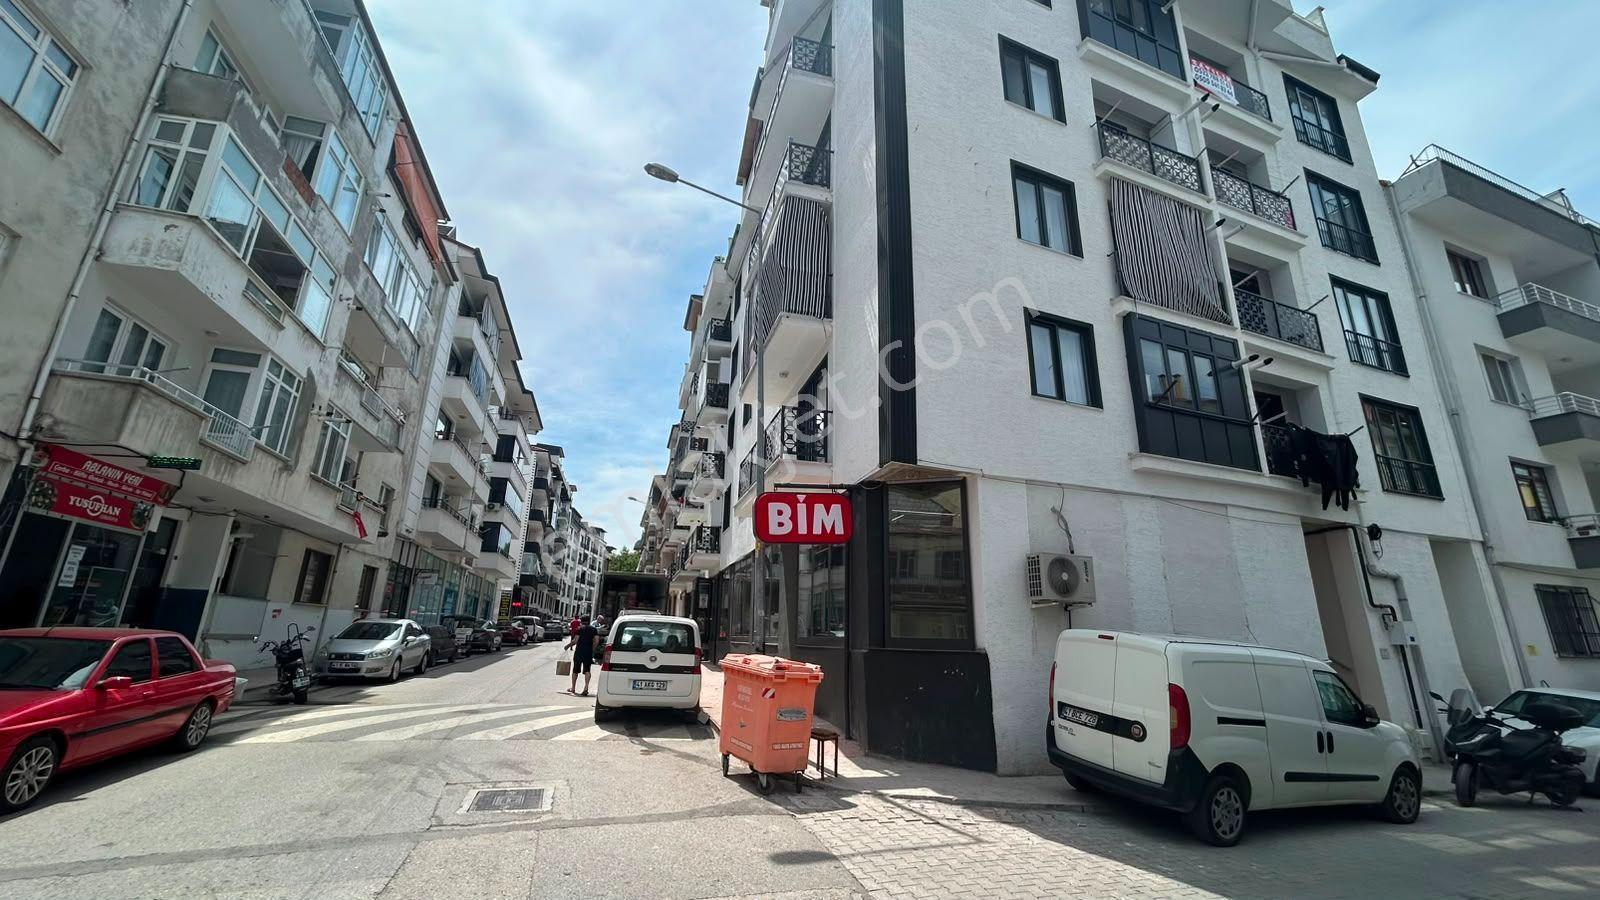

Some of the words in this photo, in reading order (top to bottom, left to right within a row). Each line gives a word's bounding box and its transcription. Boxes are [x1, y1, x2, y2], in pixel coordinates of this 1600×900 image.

[81, 460, 124, 481] ABLANIN
[69, 495, 122, 517] YUSUFHAN
[768, 494, 845, 535] BİM
